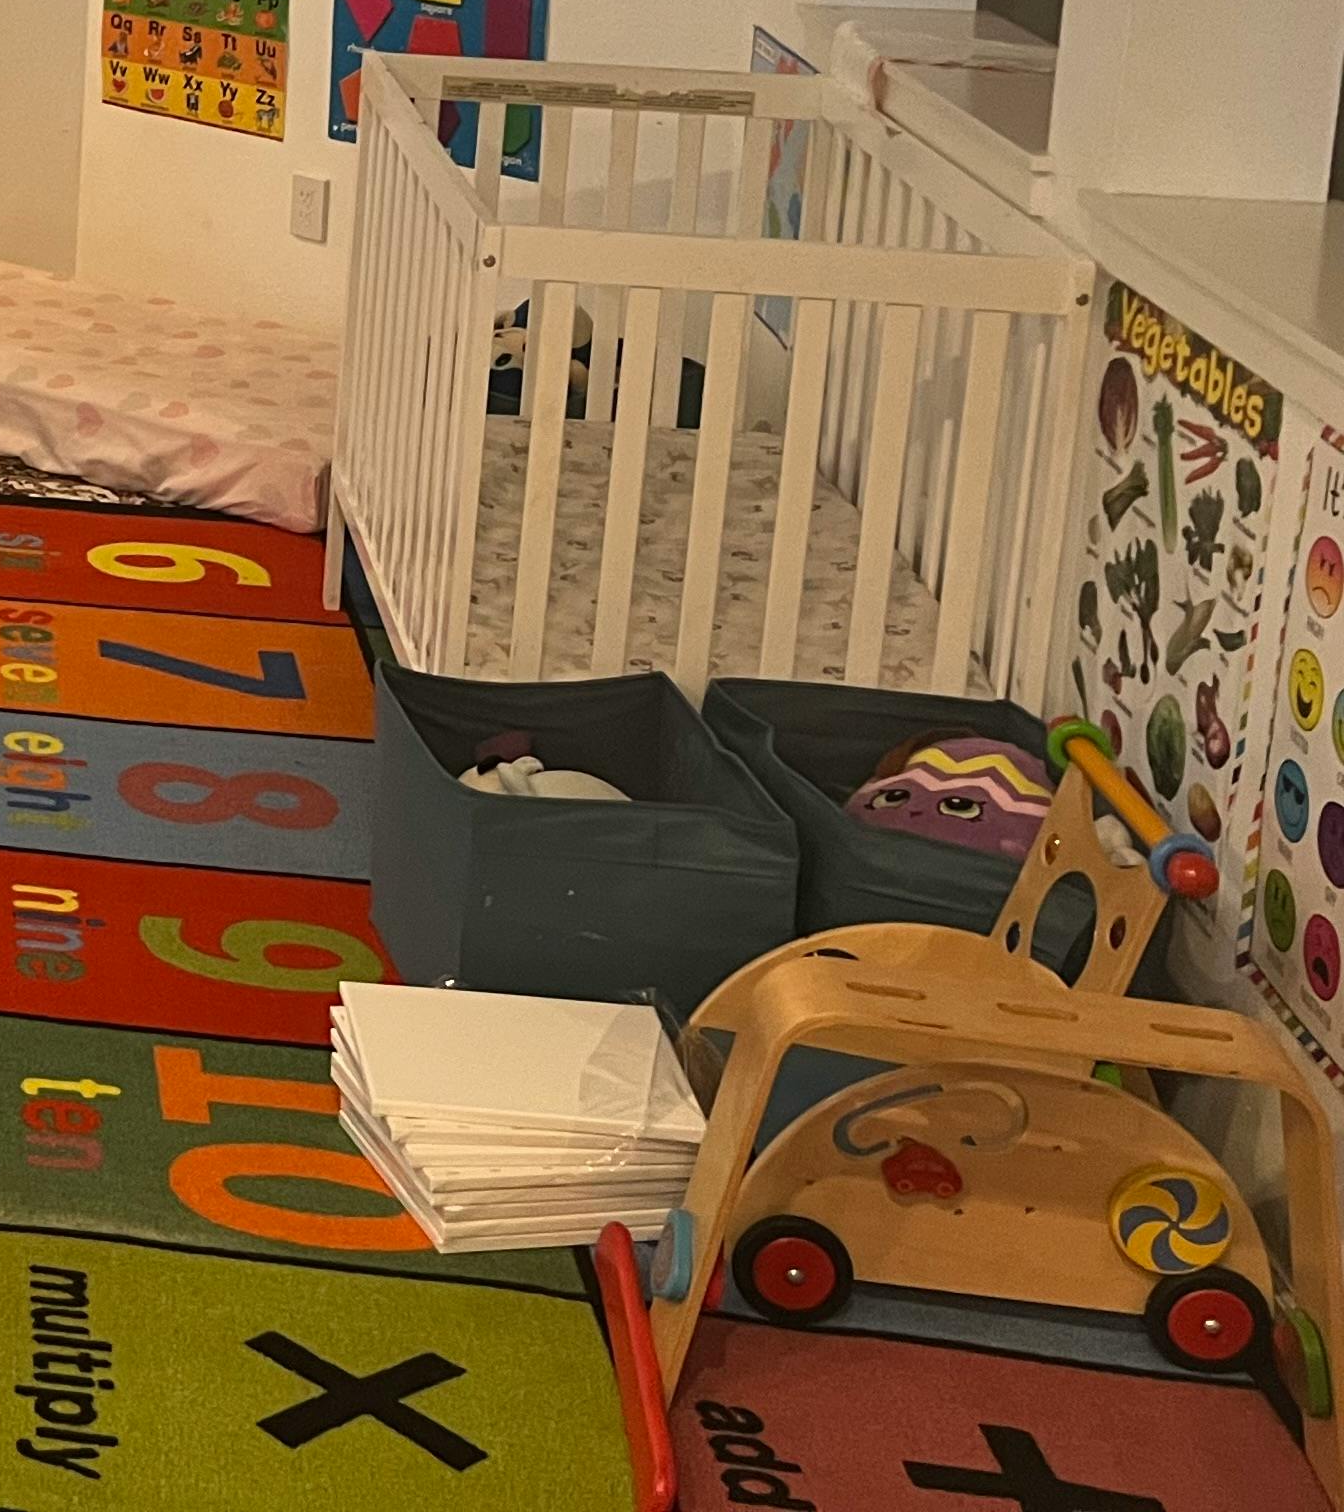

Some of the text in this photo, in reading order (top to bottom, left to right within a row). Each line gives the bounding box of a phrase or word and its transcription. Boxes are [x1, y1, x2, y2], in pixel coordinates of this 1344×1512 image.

[111, 14, 276, 58] Qq Rr Ss Tt Uu
[110, 61, 275, 107] Vv Ww Xx Yy Zz
[1121, 287, 1264, 438] Vegetables
[86, 541, 272, 587] 6
[98, 638, 308, 700] 7
[3, 729, 92, 831] eight
[116, 761, 340, 831] 8
[10, 883, 108, 986] nine
[137, 913, 383, 993] 9
[19, 1076, 121, 1171] ten
[152, 1044, 434, 1252] 10
[14, 1263, 119, 1480] multiply
[694, 1398, 817, 1512] add
